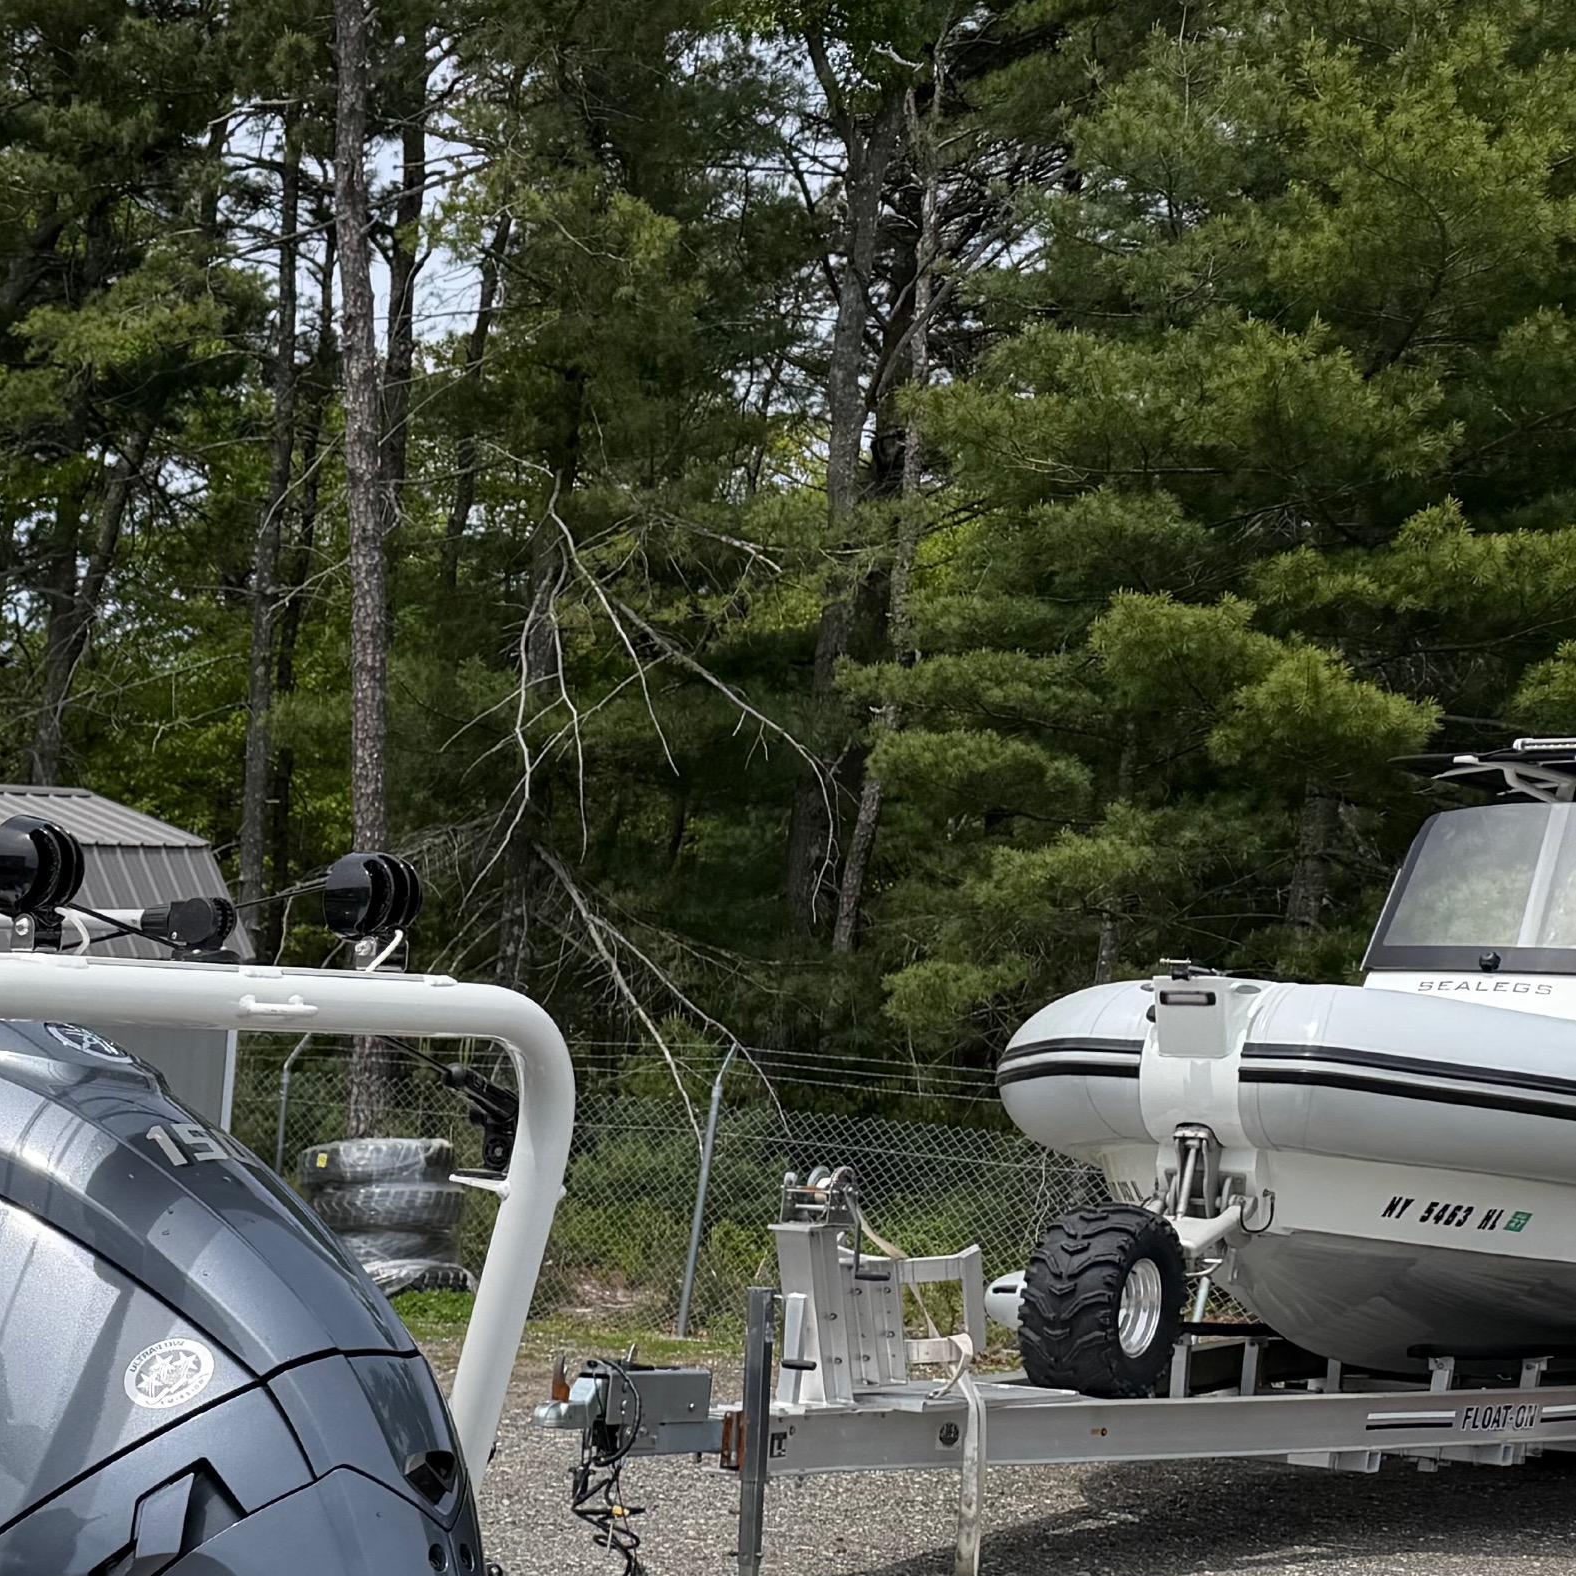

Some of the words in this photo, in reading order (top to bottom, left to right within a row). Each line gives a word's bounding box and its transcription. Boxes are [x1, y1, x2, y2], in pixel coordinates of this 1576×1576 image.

[1418, 981, 1553, 995] SEALEGS
[1381, 1196, 1415, 1219] NY
[1419, 1201, 1475, 1228] 5463
